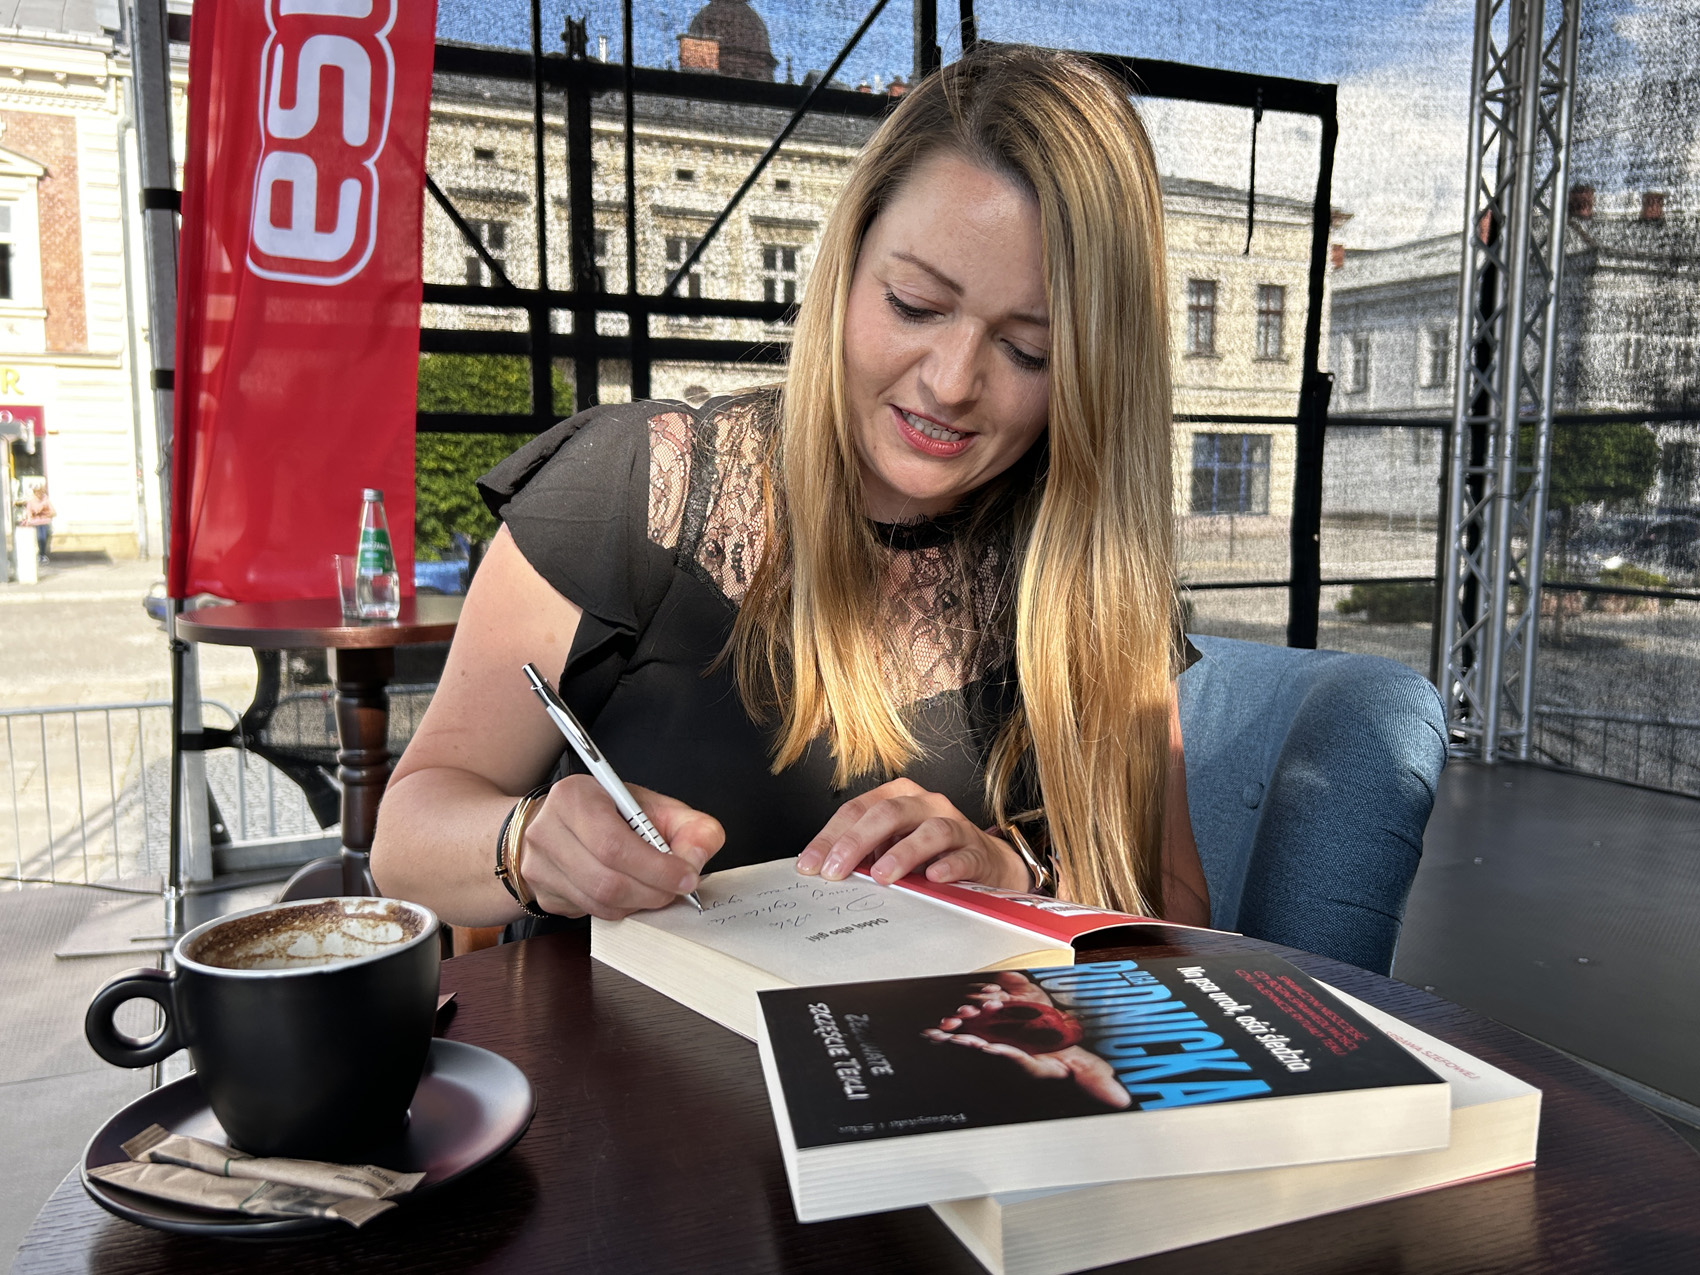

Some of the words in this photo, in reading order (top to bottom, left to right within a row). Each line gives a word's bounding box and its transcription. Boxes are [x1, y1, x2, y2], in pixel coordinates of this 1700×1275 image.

[1177, 966, 1206, 979] Na
[1190, 977, 1220, 993] psa
[1208, 991, 1252, 1016] urok,
[1027, 959, 1272, 1111] RUDNICKA
[1236, 1014, 1277, 1035] ości
[808, 1002, 851, 1058] SZCZĘŚCIE
[834, 1056, 871, 1101] TEKLI
[845, 1012, 895, 1076] ZEWATE
[1255, 1033, 1312, 1073] śledzia
